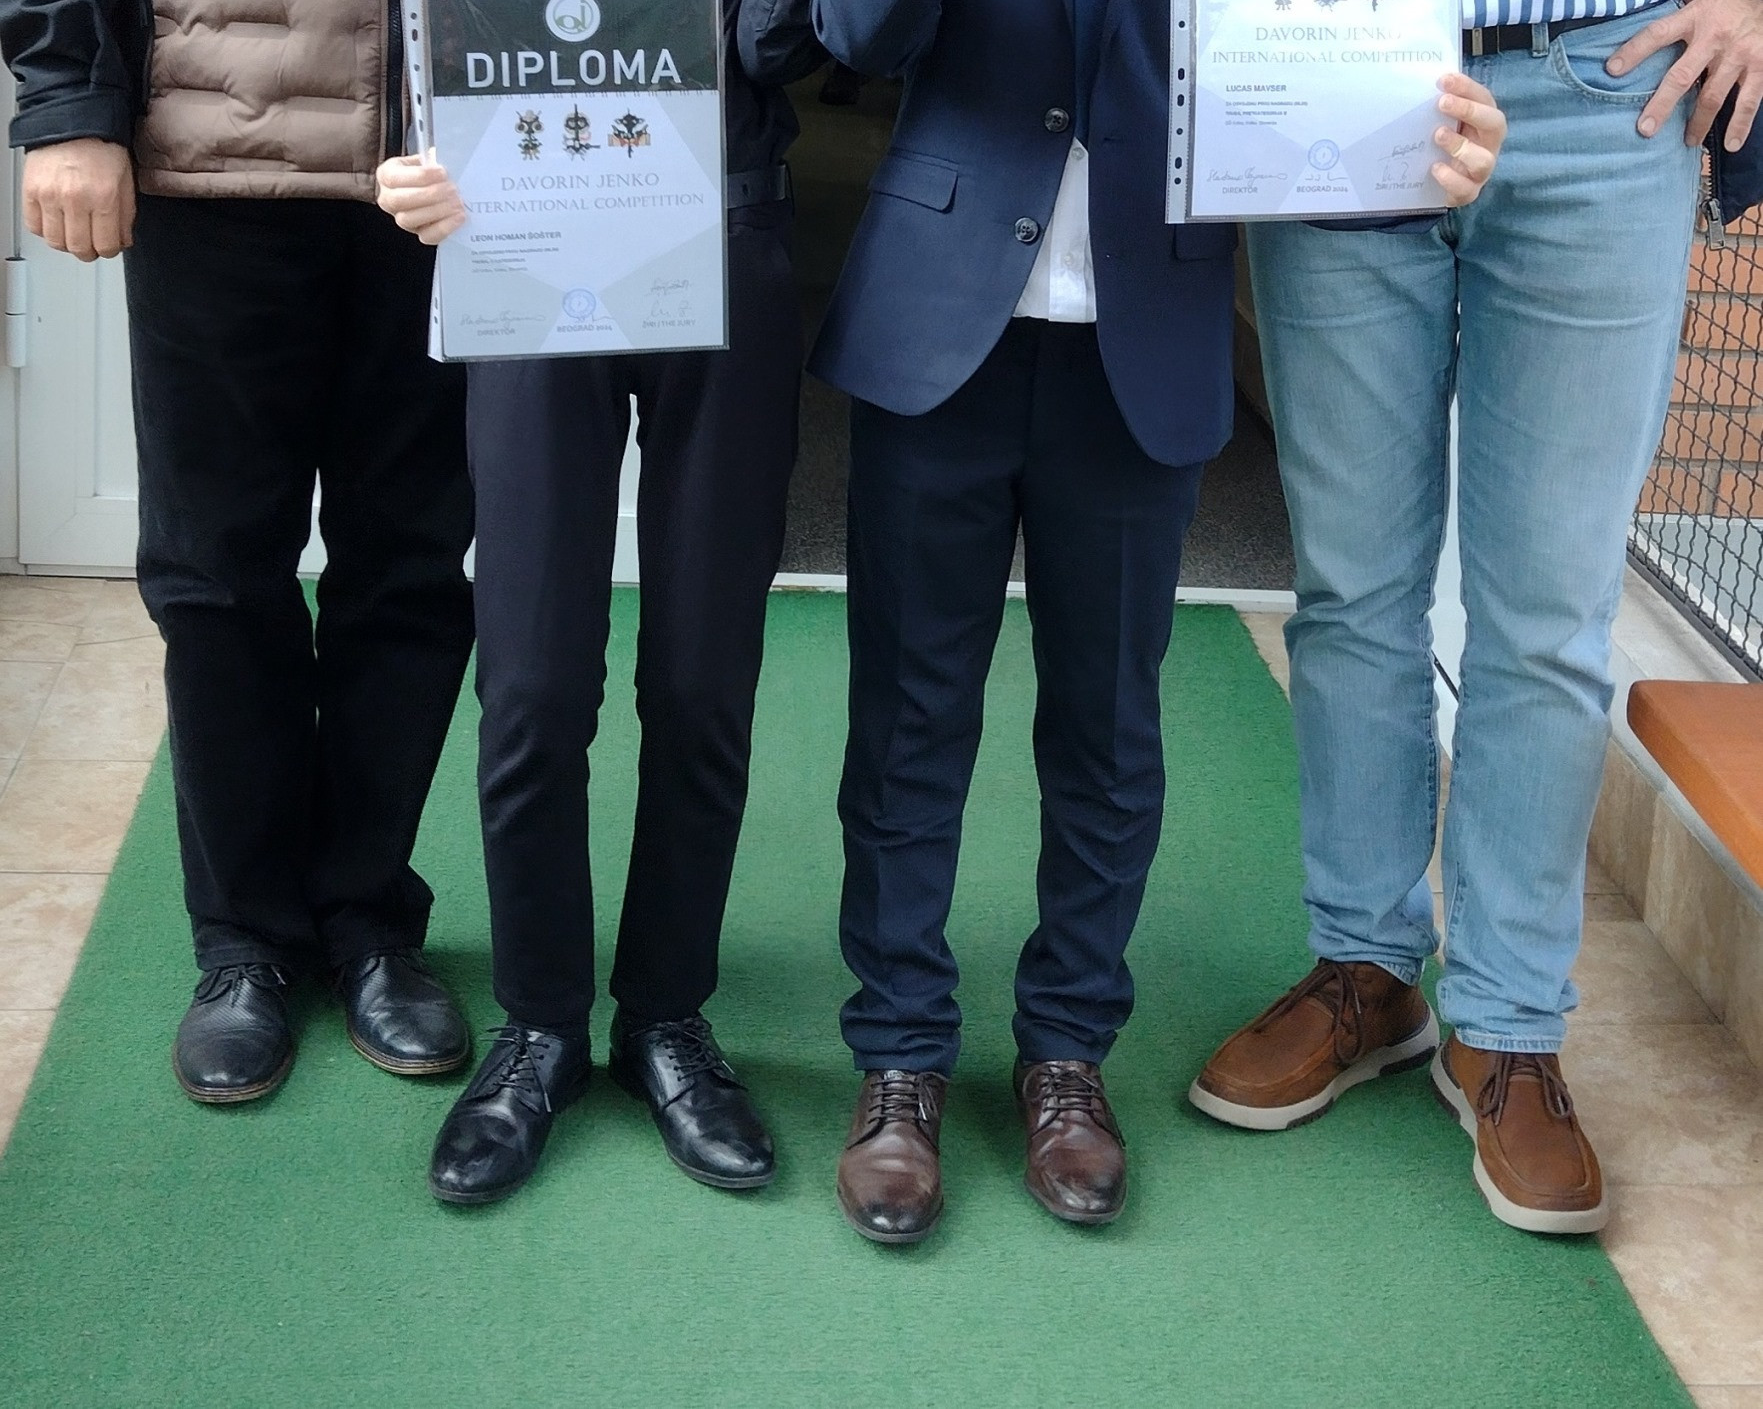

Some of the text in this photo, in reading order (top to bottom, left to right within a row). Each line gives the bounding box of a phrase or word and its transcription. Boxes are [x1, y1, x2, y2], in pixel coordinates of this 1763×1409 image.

[1255, 27, 1338, 41] DAVORIN
[1212, 50, 1443, 64] INTERNATIONAL COMPETITION
[465, 48, 682, 89] DIPLOMA
[1226, 84, 1252, 93] LUCAS
[501, 172, 660, 192] DAVORIN JENKO
[1296, 185, 1331, 193] BEOGRAD
[462, 193, 704, 215] NTERNATIONAL COMPETITION
[470, 233, 493, 243] LEON
[495, 232, 526, 242] HOMAN
[557, 324, 594, 333] BEOGRAD
